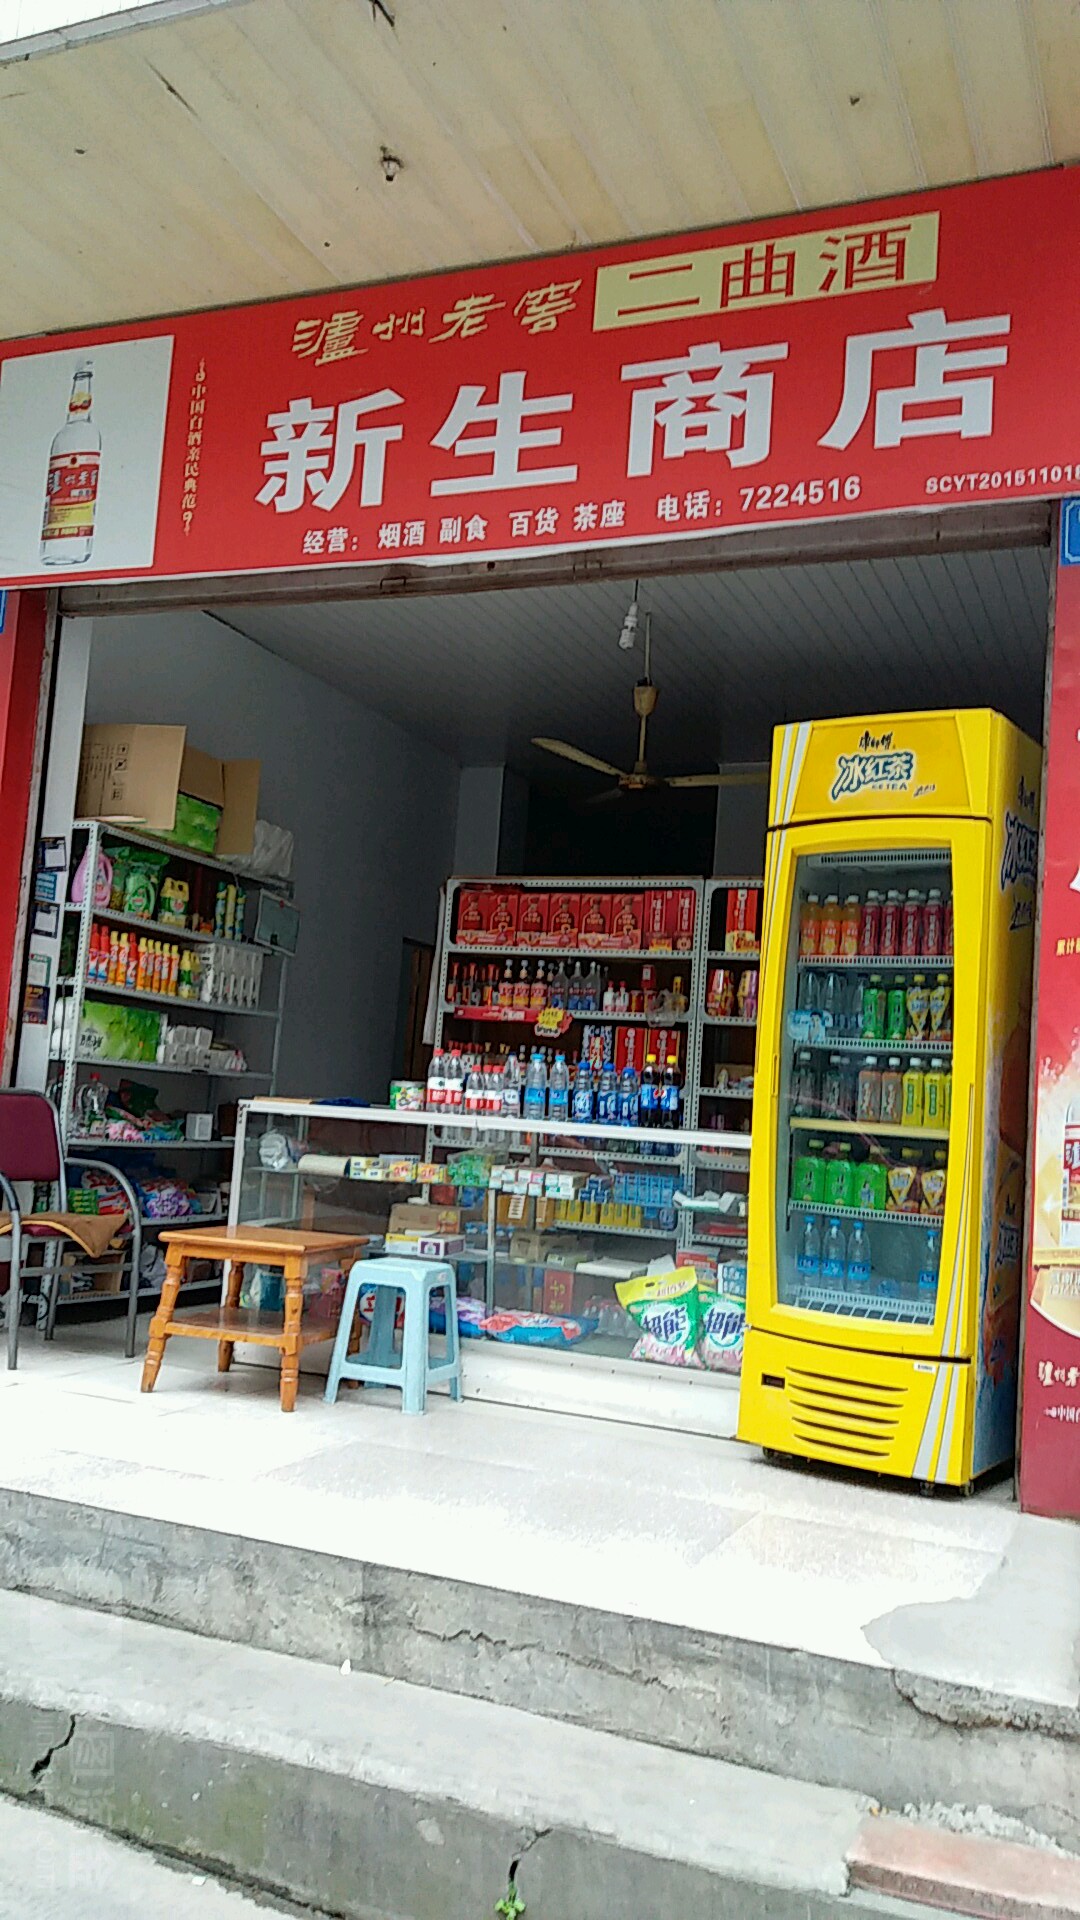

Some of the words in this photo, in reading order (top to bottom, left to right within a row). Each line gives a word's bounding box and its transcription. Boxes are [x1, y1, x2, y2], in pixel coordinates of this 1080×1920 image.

[617, 223, 911, 317] 二曲酒
[255, 308, 1011, 514] 新生商店
[378, 519, 425, 549] 烟酒
[439, 514, 488, 543] 副食
[508, 507, 559, 538] 百货
[573, 500, 625, 531] 茶座
[740, 475, 861, 512] 7224516
[831, 751, 914, 801] 冰红茶
[643, 1306, 687, 1341] 超能
